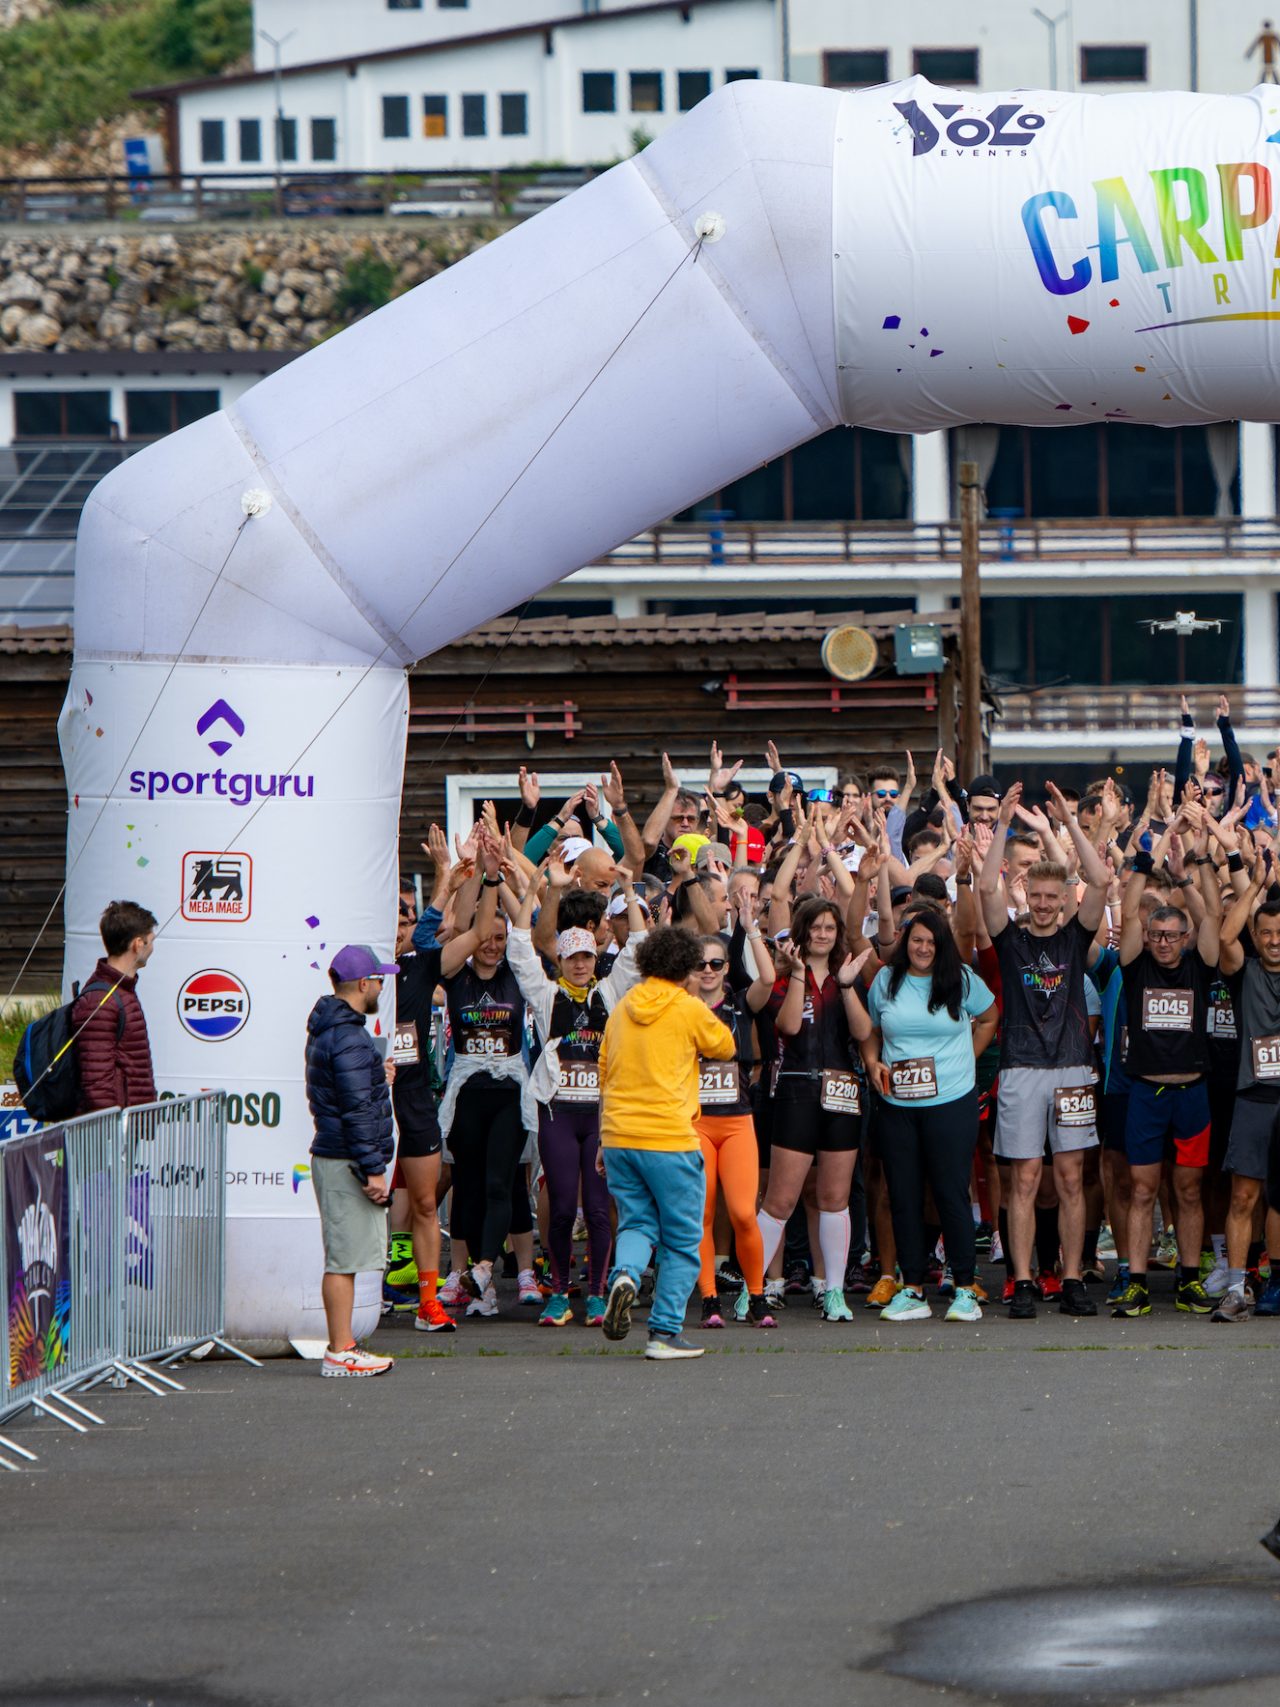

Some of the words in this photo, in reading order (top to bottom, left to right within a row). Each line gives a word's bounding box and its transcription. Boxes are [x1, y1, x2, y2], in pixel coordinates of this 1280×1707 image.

[129, 767, 314, 806] sportguru
[189, 901, 214, 914] MEGA
[216, 902, 243, 914] IMAGE
[184, 998, 243, 1013] PEPSI
[1147, 999, 1189, 1014] 6045
[466, 1037, 505, 1054] 6364
[560, 1070, 598, 1088] 6108
[893, 1067, 932, 1086] 6276
[826, 1080, 858, 1099] 6280
[1060, 1095, 1094, 1112] 6346
[252, 1171, 285, 1186] THE
